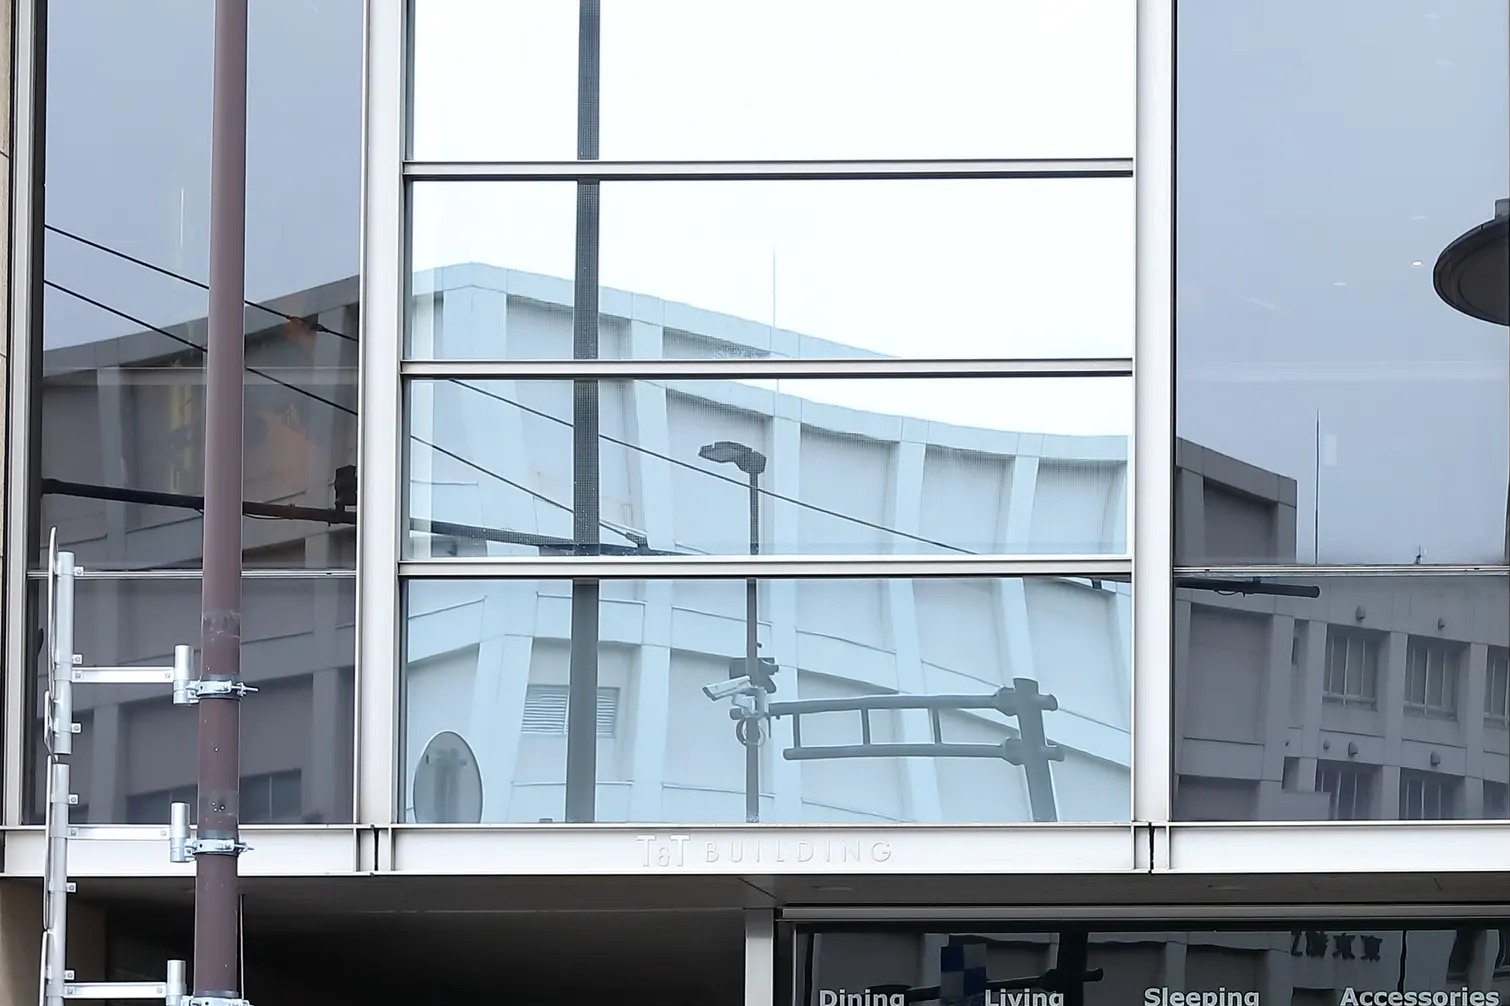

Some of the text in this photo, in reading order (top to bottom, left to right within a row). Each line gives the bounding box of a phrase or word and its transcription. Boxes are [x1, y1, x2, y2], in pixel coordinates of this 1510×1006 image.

[636, 834, 892, 867] T&T BUILDING
[1339, 986, 1500, 1006] Accessories
